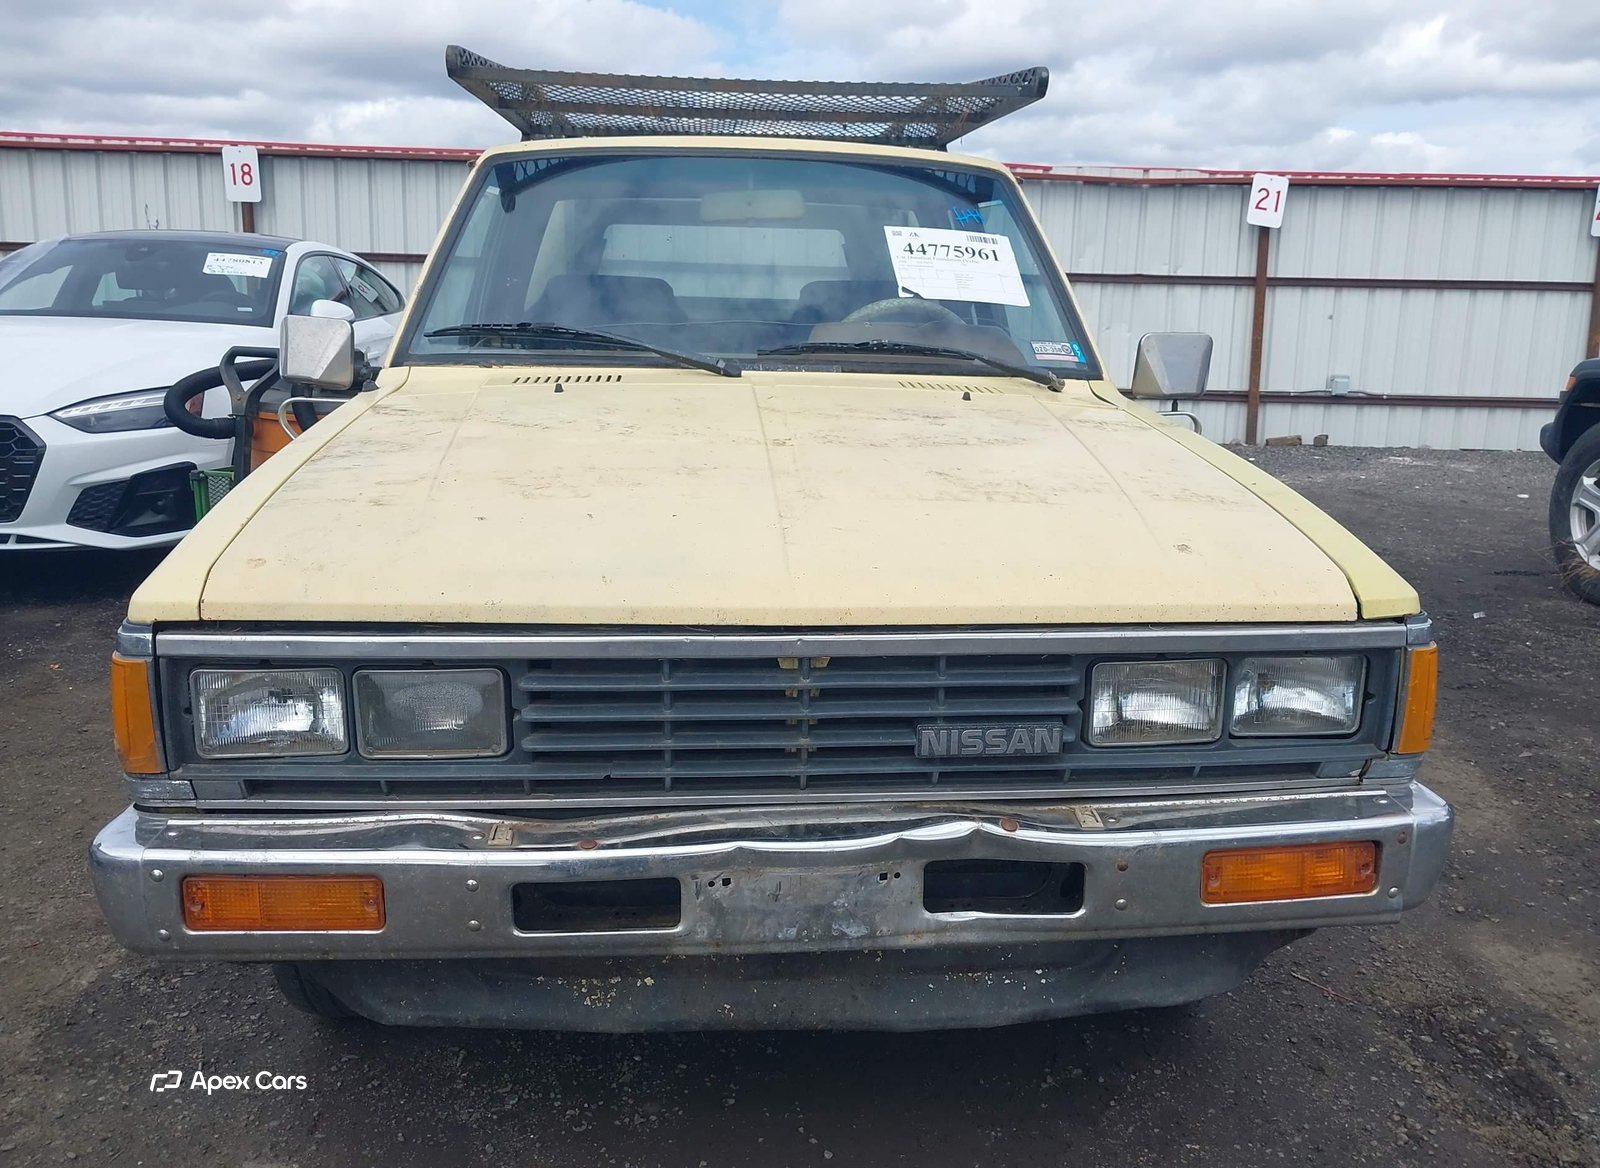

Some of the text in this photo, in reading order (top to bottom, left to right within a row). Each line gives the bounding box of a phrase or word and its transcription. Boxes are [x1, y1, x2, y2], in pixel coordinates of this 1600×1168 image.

[230, 162, 253, 186] 18
[1255, 187, 1281, 213] 21
[903, 242, 1001, 263] 44775961
[920, 728, 1061, 756] NISSAN
